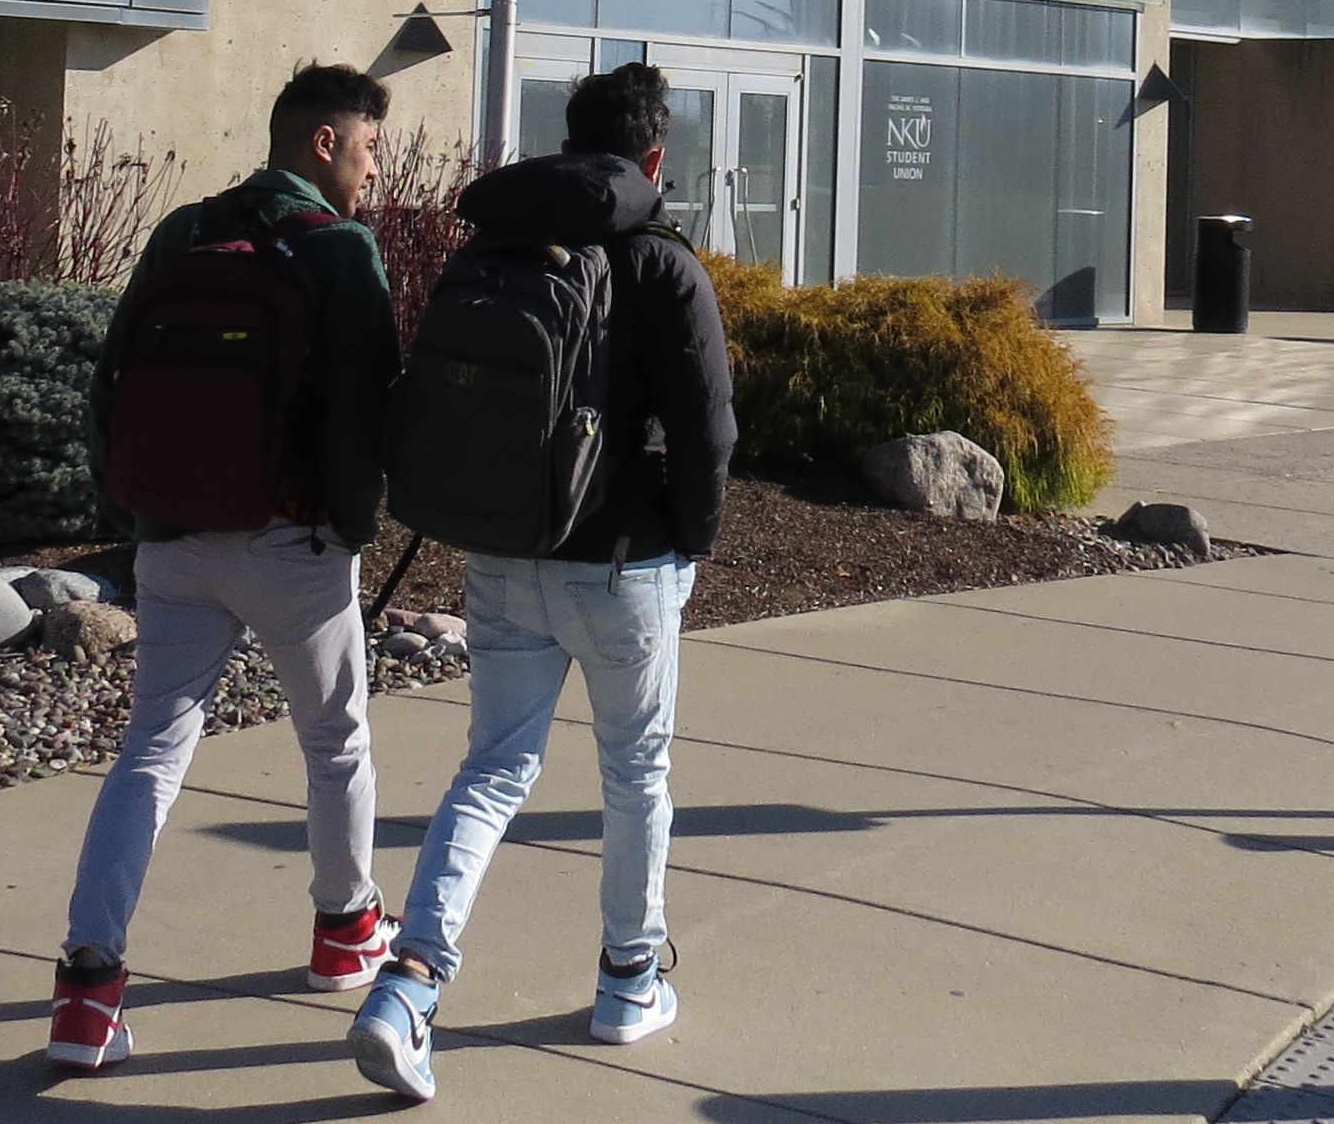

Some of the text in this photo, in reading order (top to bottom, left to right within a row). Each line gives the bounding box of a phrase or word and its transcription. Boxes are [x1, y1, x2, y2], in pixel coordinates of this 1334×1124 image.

[886, 116, 932, 150] NKU
[886, 151, 931, 164] STUDENT
[893, 167, 923, 180] UNION
